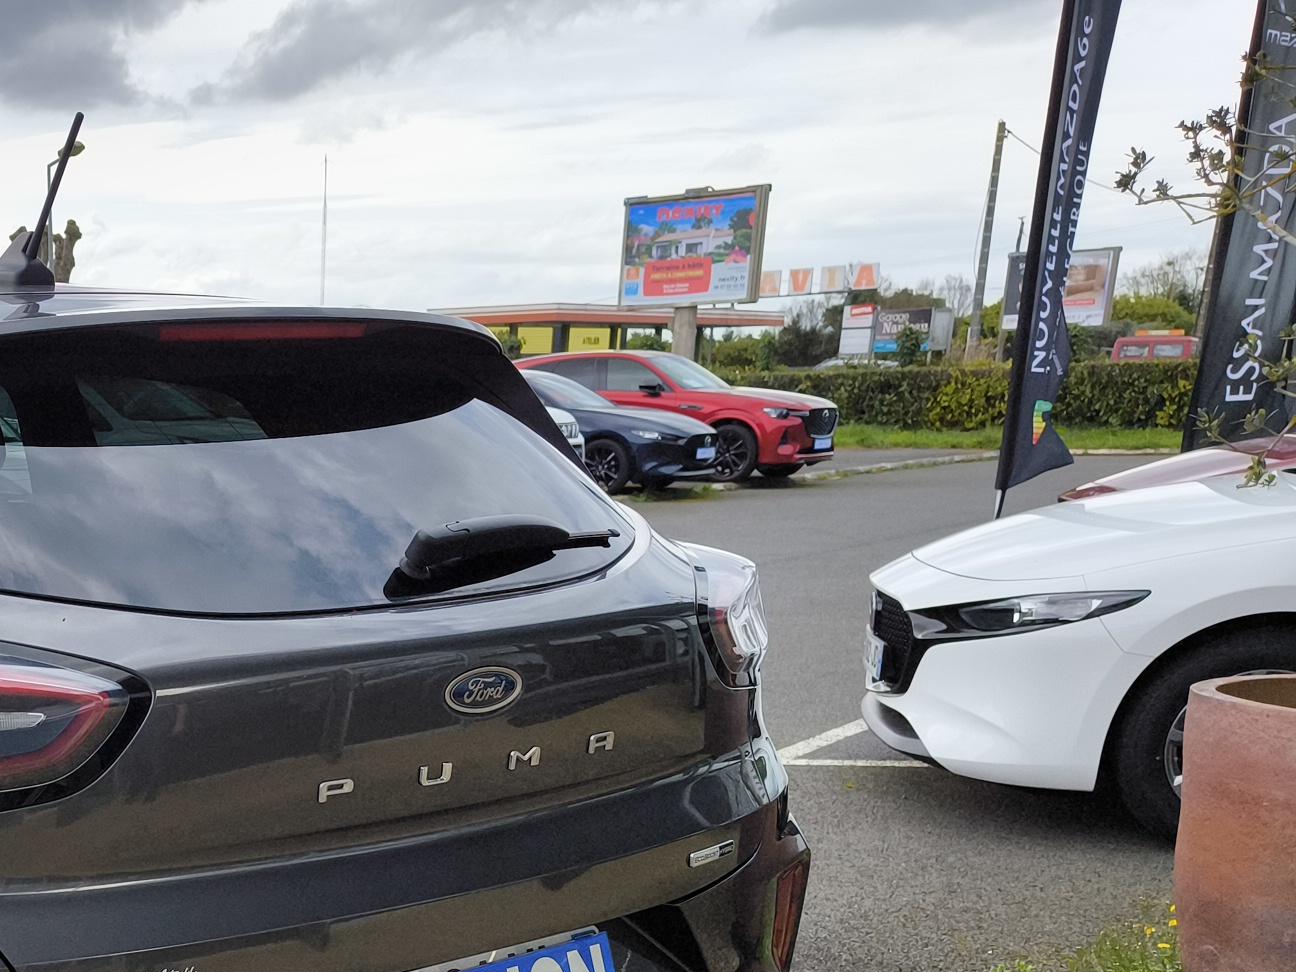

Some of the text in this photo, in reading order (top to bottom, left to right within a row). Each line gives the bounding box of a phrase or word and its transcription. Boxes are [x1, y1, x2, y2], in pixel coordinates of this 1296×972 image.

[1031, 205, 1062, 374] NOUVELLE
[1056, 15, 1093, 195] MAZDA6e
[1225, 298, 1267, 402] ESSAI
[464, 676, 506, 704] Ford
[318, 731, 615, 803] PUMA
